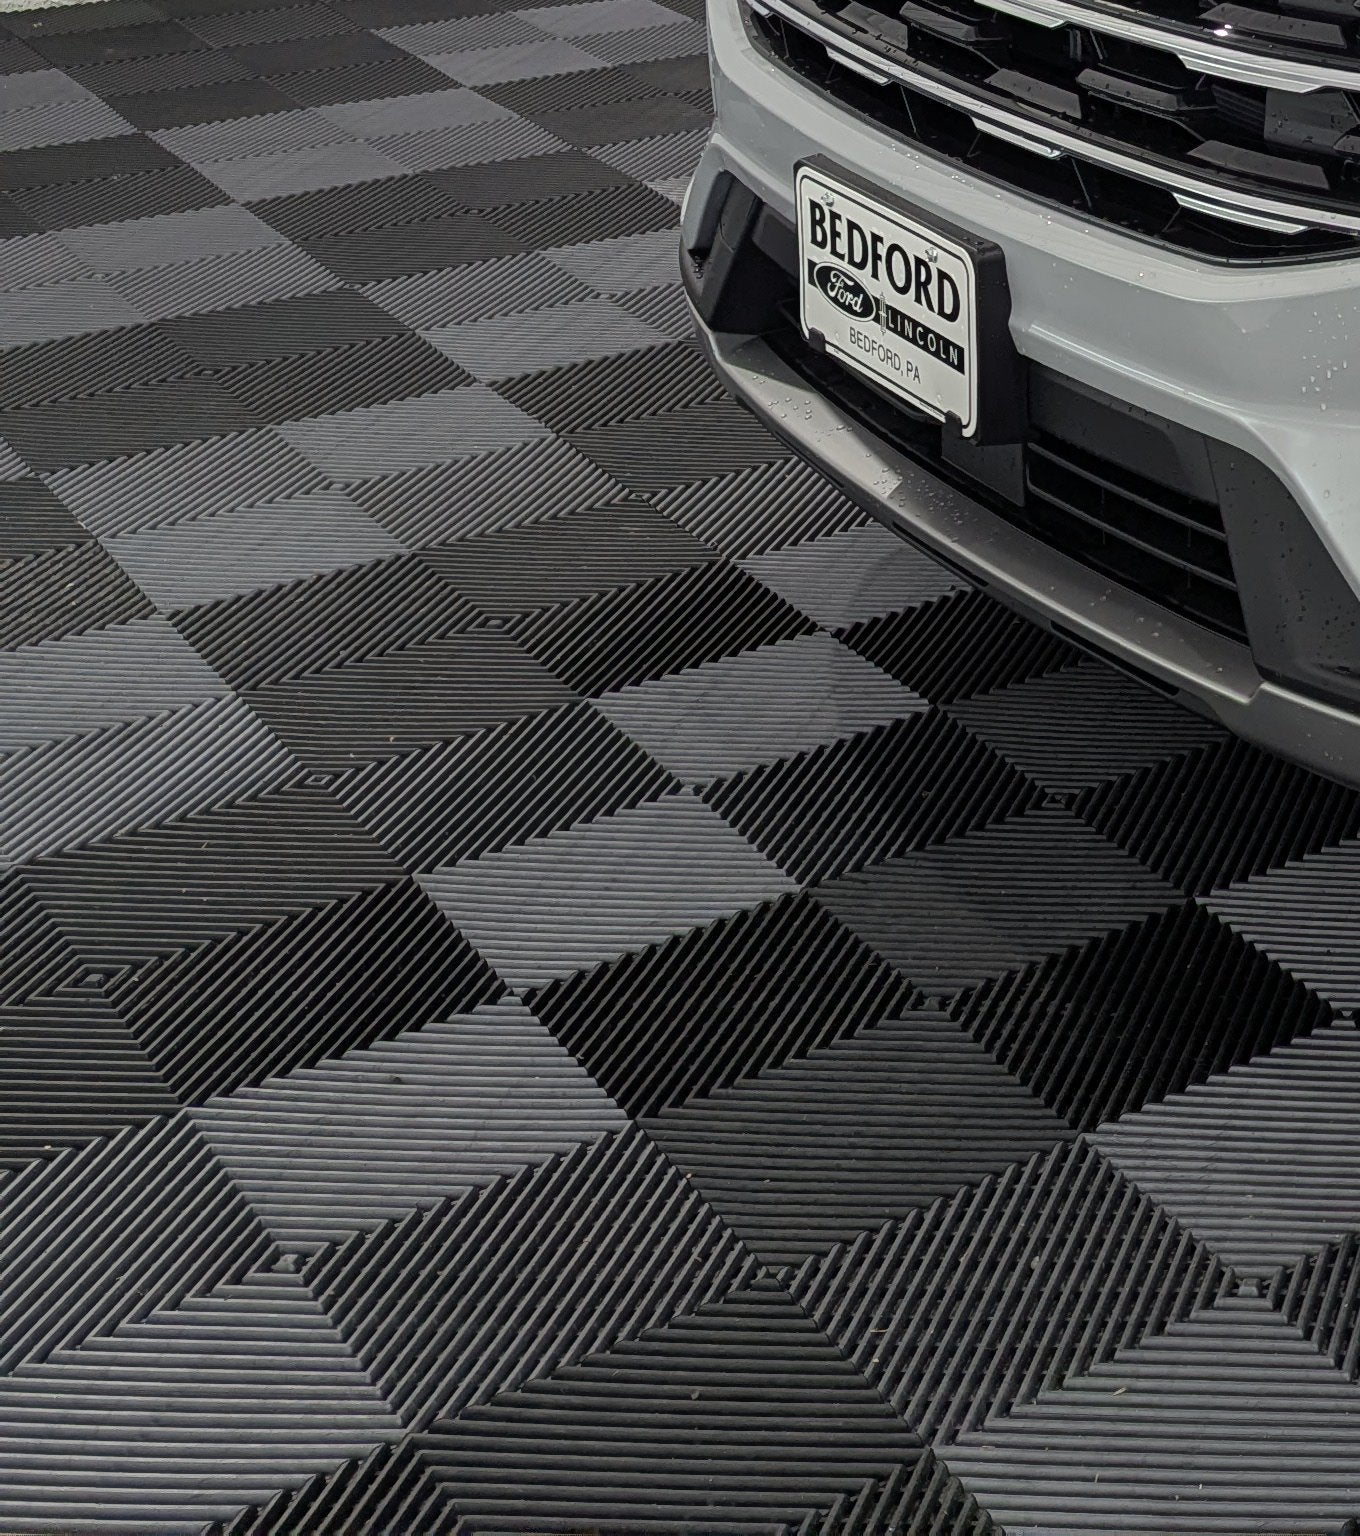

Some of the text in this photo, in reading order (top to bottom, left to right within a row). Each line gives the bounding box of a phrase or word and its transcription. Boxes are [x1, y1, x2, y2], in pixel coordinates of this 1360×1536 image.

[808, 197, 961, 324] BEDFORD
[826, 270, 865, 314] Ford
[849, 326, 922, 385] BEDFORD, PA
[888, 314, 959, 367] LINCOLN
